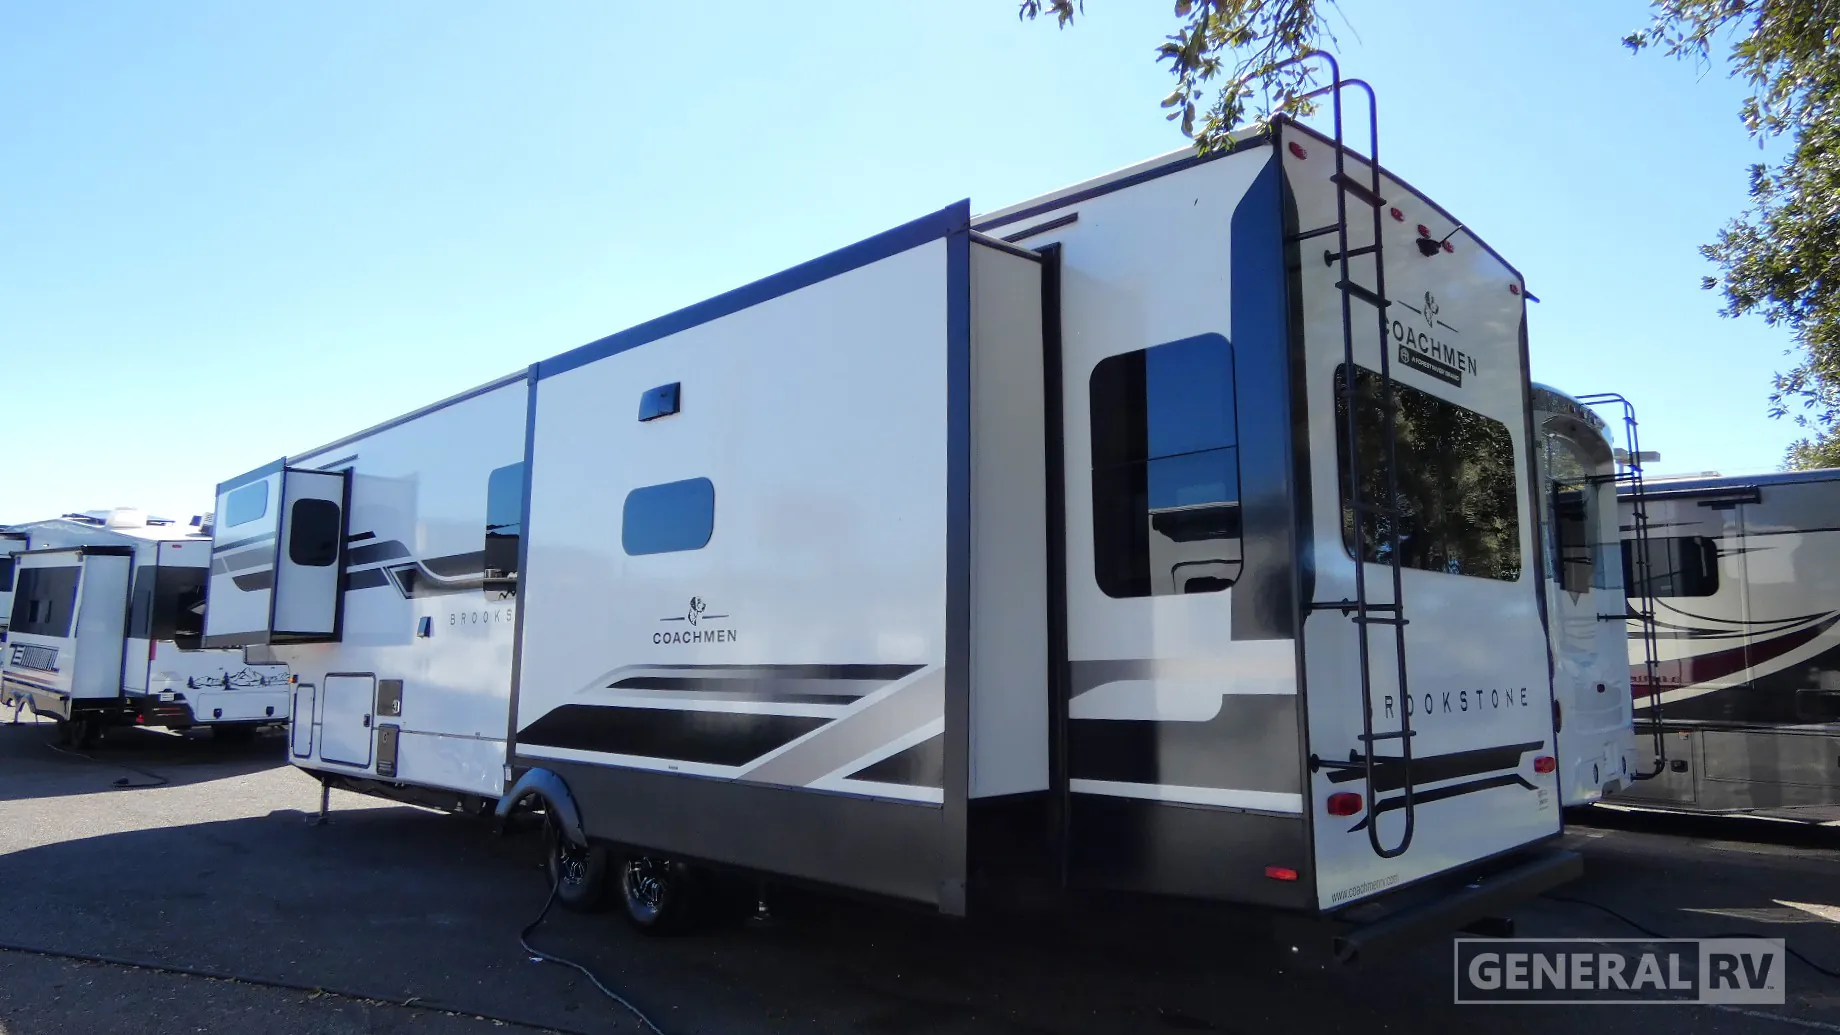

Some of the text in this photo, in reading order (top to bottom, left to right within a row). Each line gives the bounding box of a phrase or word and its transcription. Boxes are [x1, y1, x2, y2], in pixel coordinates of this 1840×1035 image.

[450, 609, 512, 626] BROOKS
[652, 629, 737, 645] COACHMEN
[1367, 687, 1528, 719] ROOKSTONE
